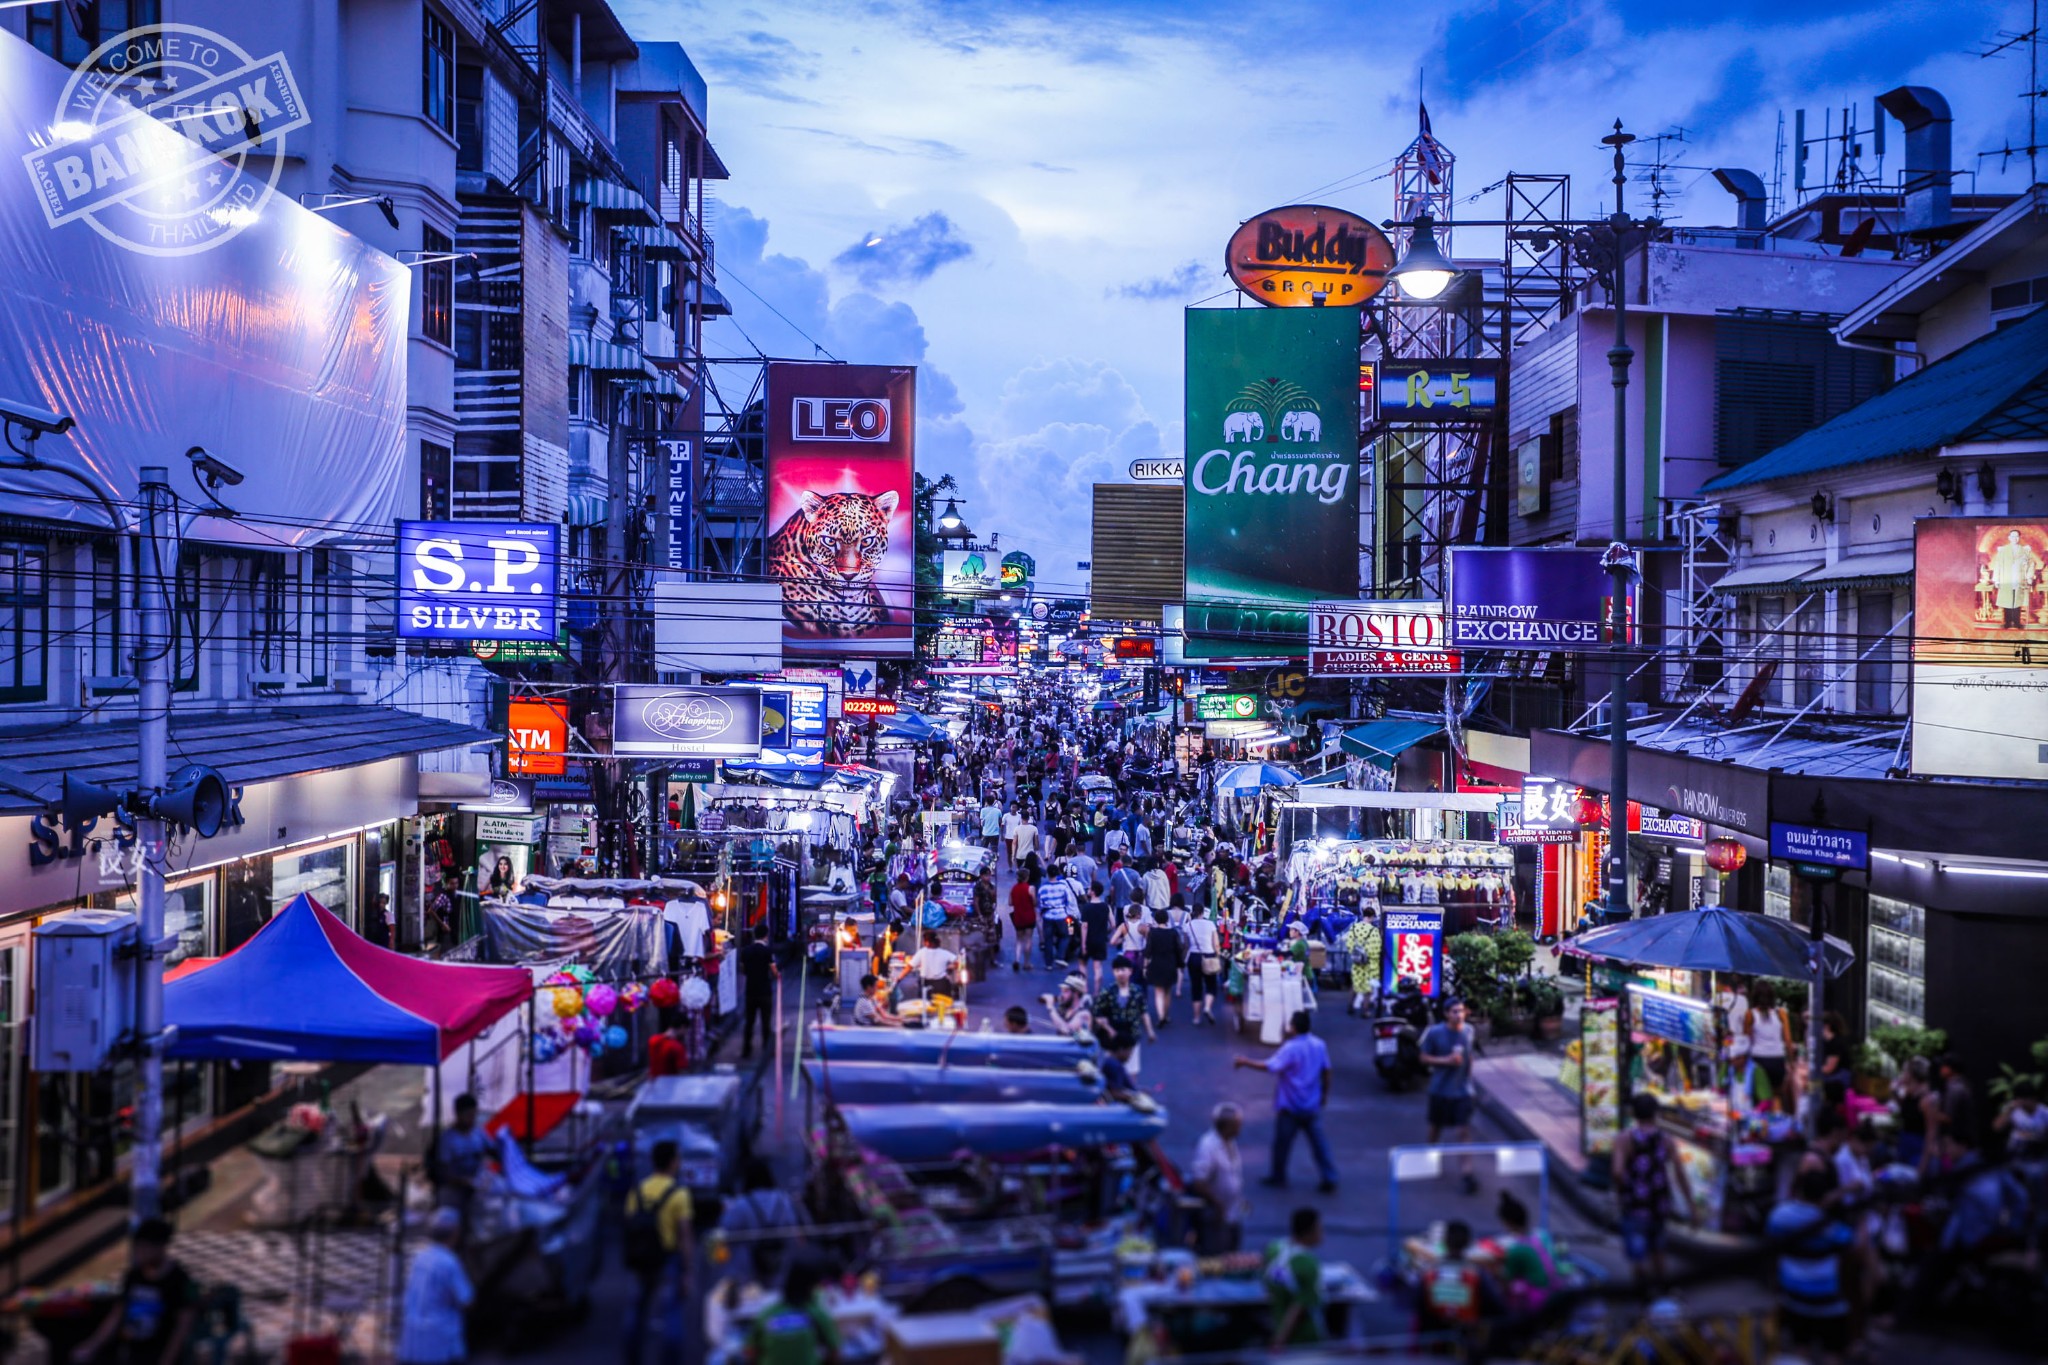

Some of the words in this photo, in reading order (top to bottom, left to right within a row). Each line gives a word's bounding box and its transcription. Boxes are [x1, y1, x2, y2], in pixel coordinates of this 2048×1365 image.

[1256, 220, 1368, 274] Buddy
[1261, 279, 1353, 295] GROUP
[1406, 370, 1471, 408] R-5
[796, 400, 888, 440] LEO
[1135, 463, 1183, 476] RIKKA
[1192, 449, 1350, 504] Chang
[413, 538, 543, 594] S.P.
[411, 606, 543, 630] SILVER
[1457, 605, 1538, 619] RAINBOW
[1457, 620, 1597, 641] EXCHANGE
[1326, 652, 1377, 662] LADIES
[1383, 652, 1395, 661] &
[1402, 652, 1448, 662] GENTS
[1323, 663, 1383, 672] CUSTOM
[1390, 662, 1451, 672] TAILORS
[1271, 673, 1305, 697] JC
[672, 744, 705, 752] Hostel
[1684, 788, 1718, 817] RAINBOW
[1718, 806, 1736, 822] SILVER
[1736, 811, 1747, 826] 925
[491, 820, 508, 829] ATM
[1641, 818, 1690, 835] EXCHANGE
[1786, 829, 1852, 850] ถนนข้าวสาร
[1787, 845, 1812, 855] Thanon
[1815, 849, 1833, 858] Khao
[1836, 851, 1850, 860] San
[1386, 913, 1418, 921] RAINBOW
[1386, 921, 1441, 930] EXCHANGE
